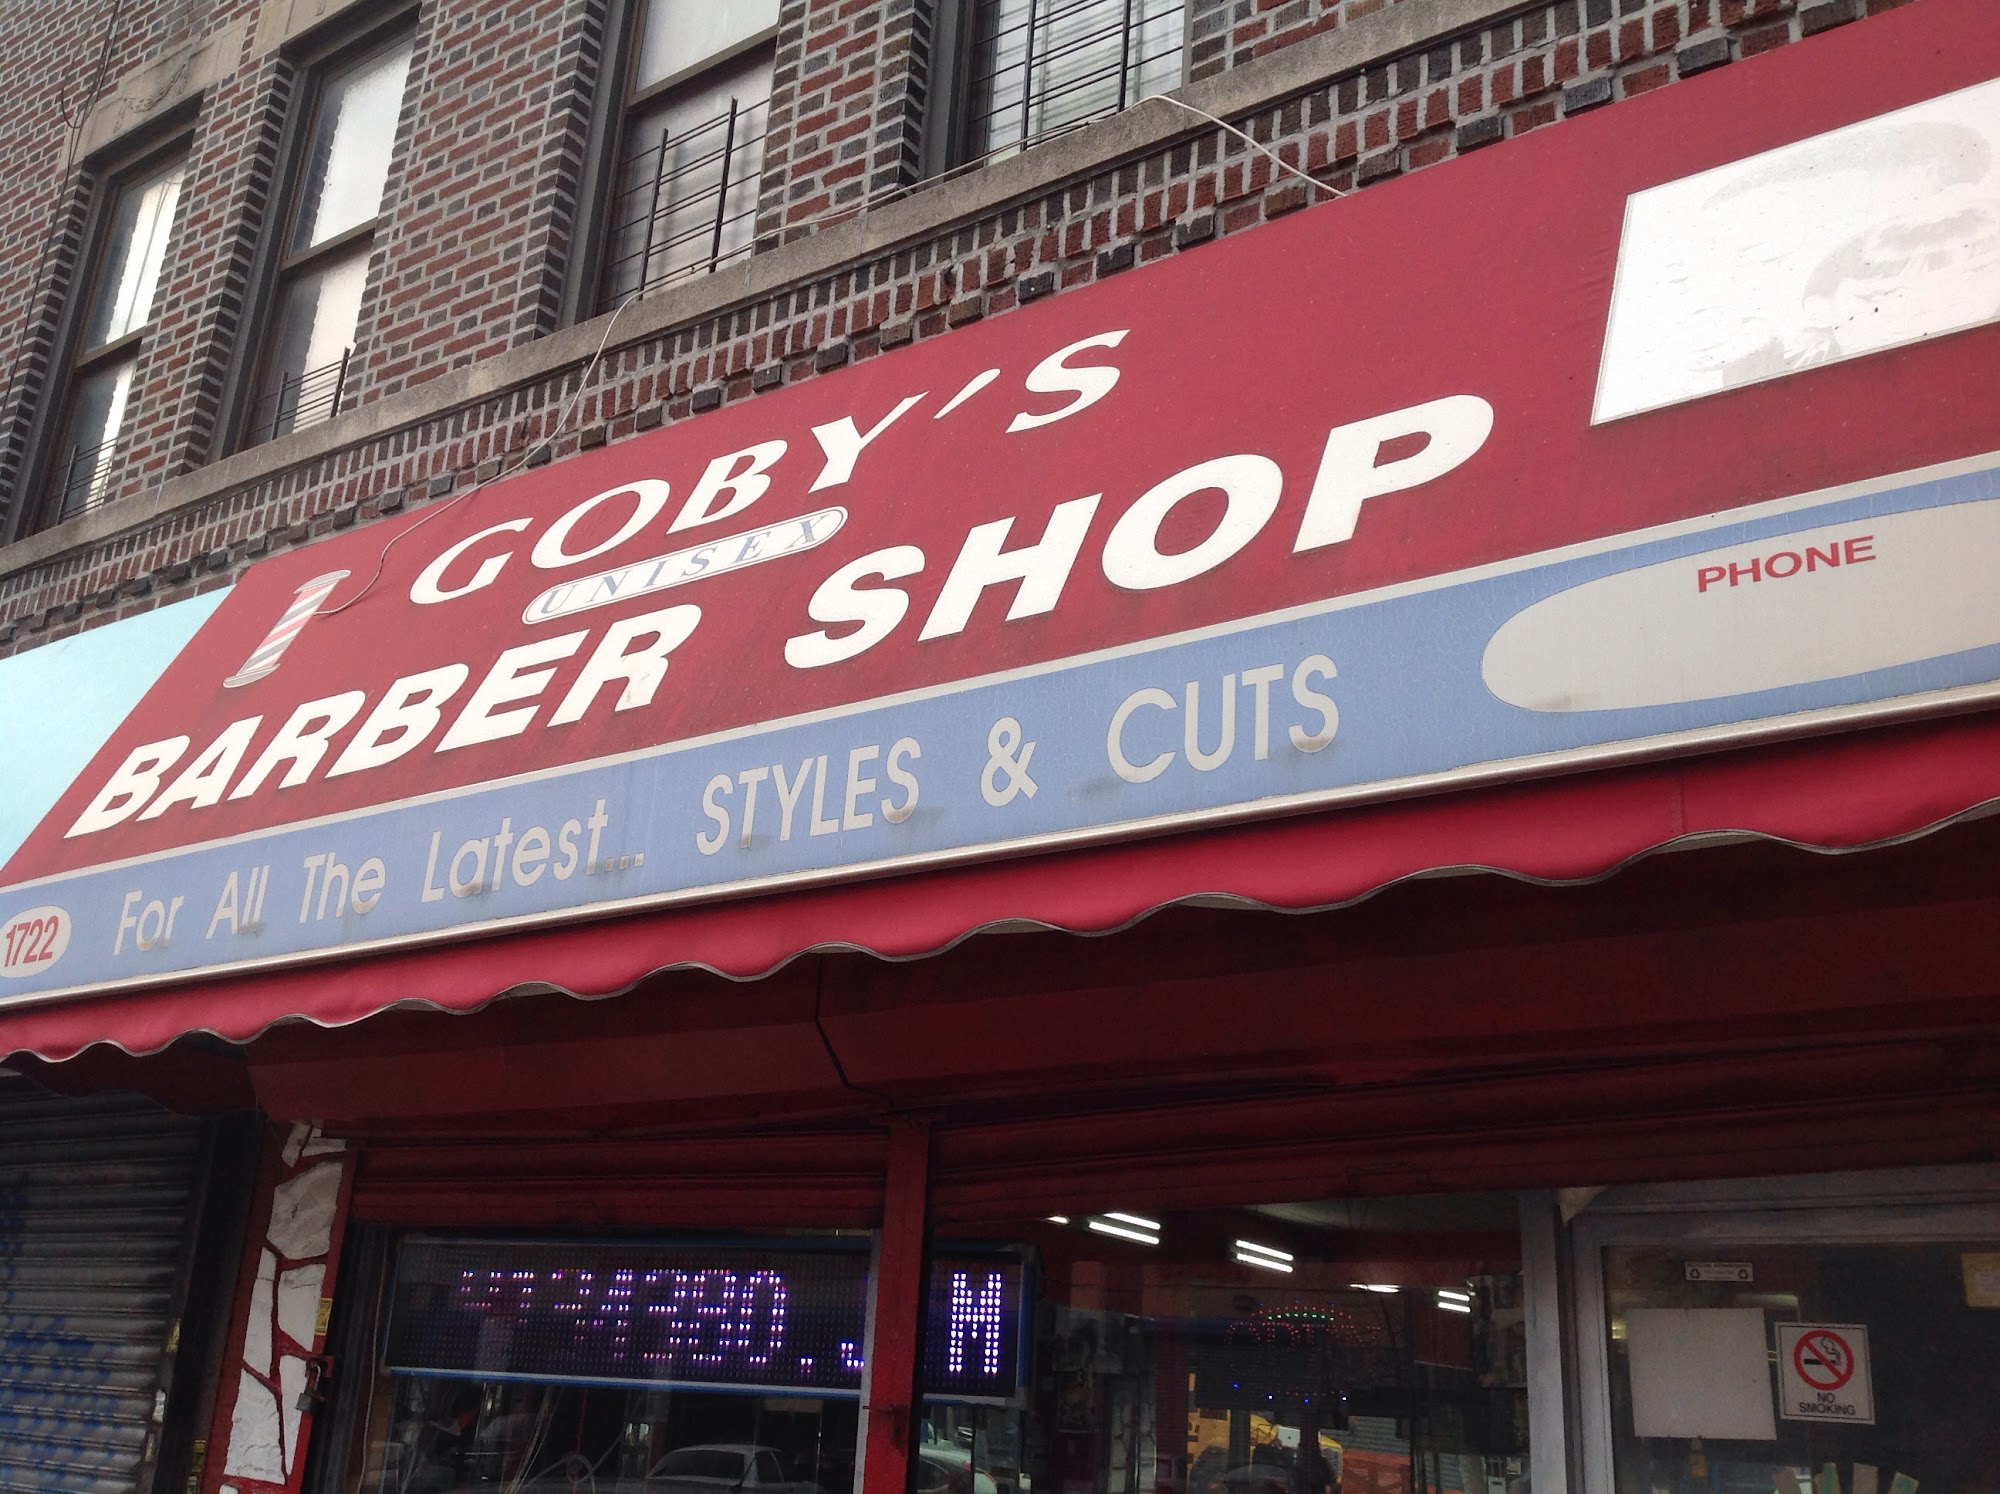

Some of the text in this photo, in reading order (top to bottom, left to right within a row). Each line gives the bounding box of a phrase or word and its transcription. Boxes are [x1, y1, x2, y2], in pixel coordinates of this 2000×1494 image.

[410, 329, 1131, 605] GOBY'S
[539, 515, 829, 615] UNISEX
[1696, 535, 1875, 593] PHONE
[64, 395, 1494, 839] BARBER SHOP
[113, 889, 185, 955] For
[206, 865, 271, 939] All
[299, 852, 387, 924] The
[696, 736, 922, 856] STYLES
[980, 716, 1039, 807] &
[1107, 655, 1341, 783] CUTS
[4, 915, 60, 968] 1722
[1798, 1402, 1856, 1416] SMOKING
[1816, 1392, 1836, 1404] NO
